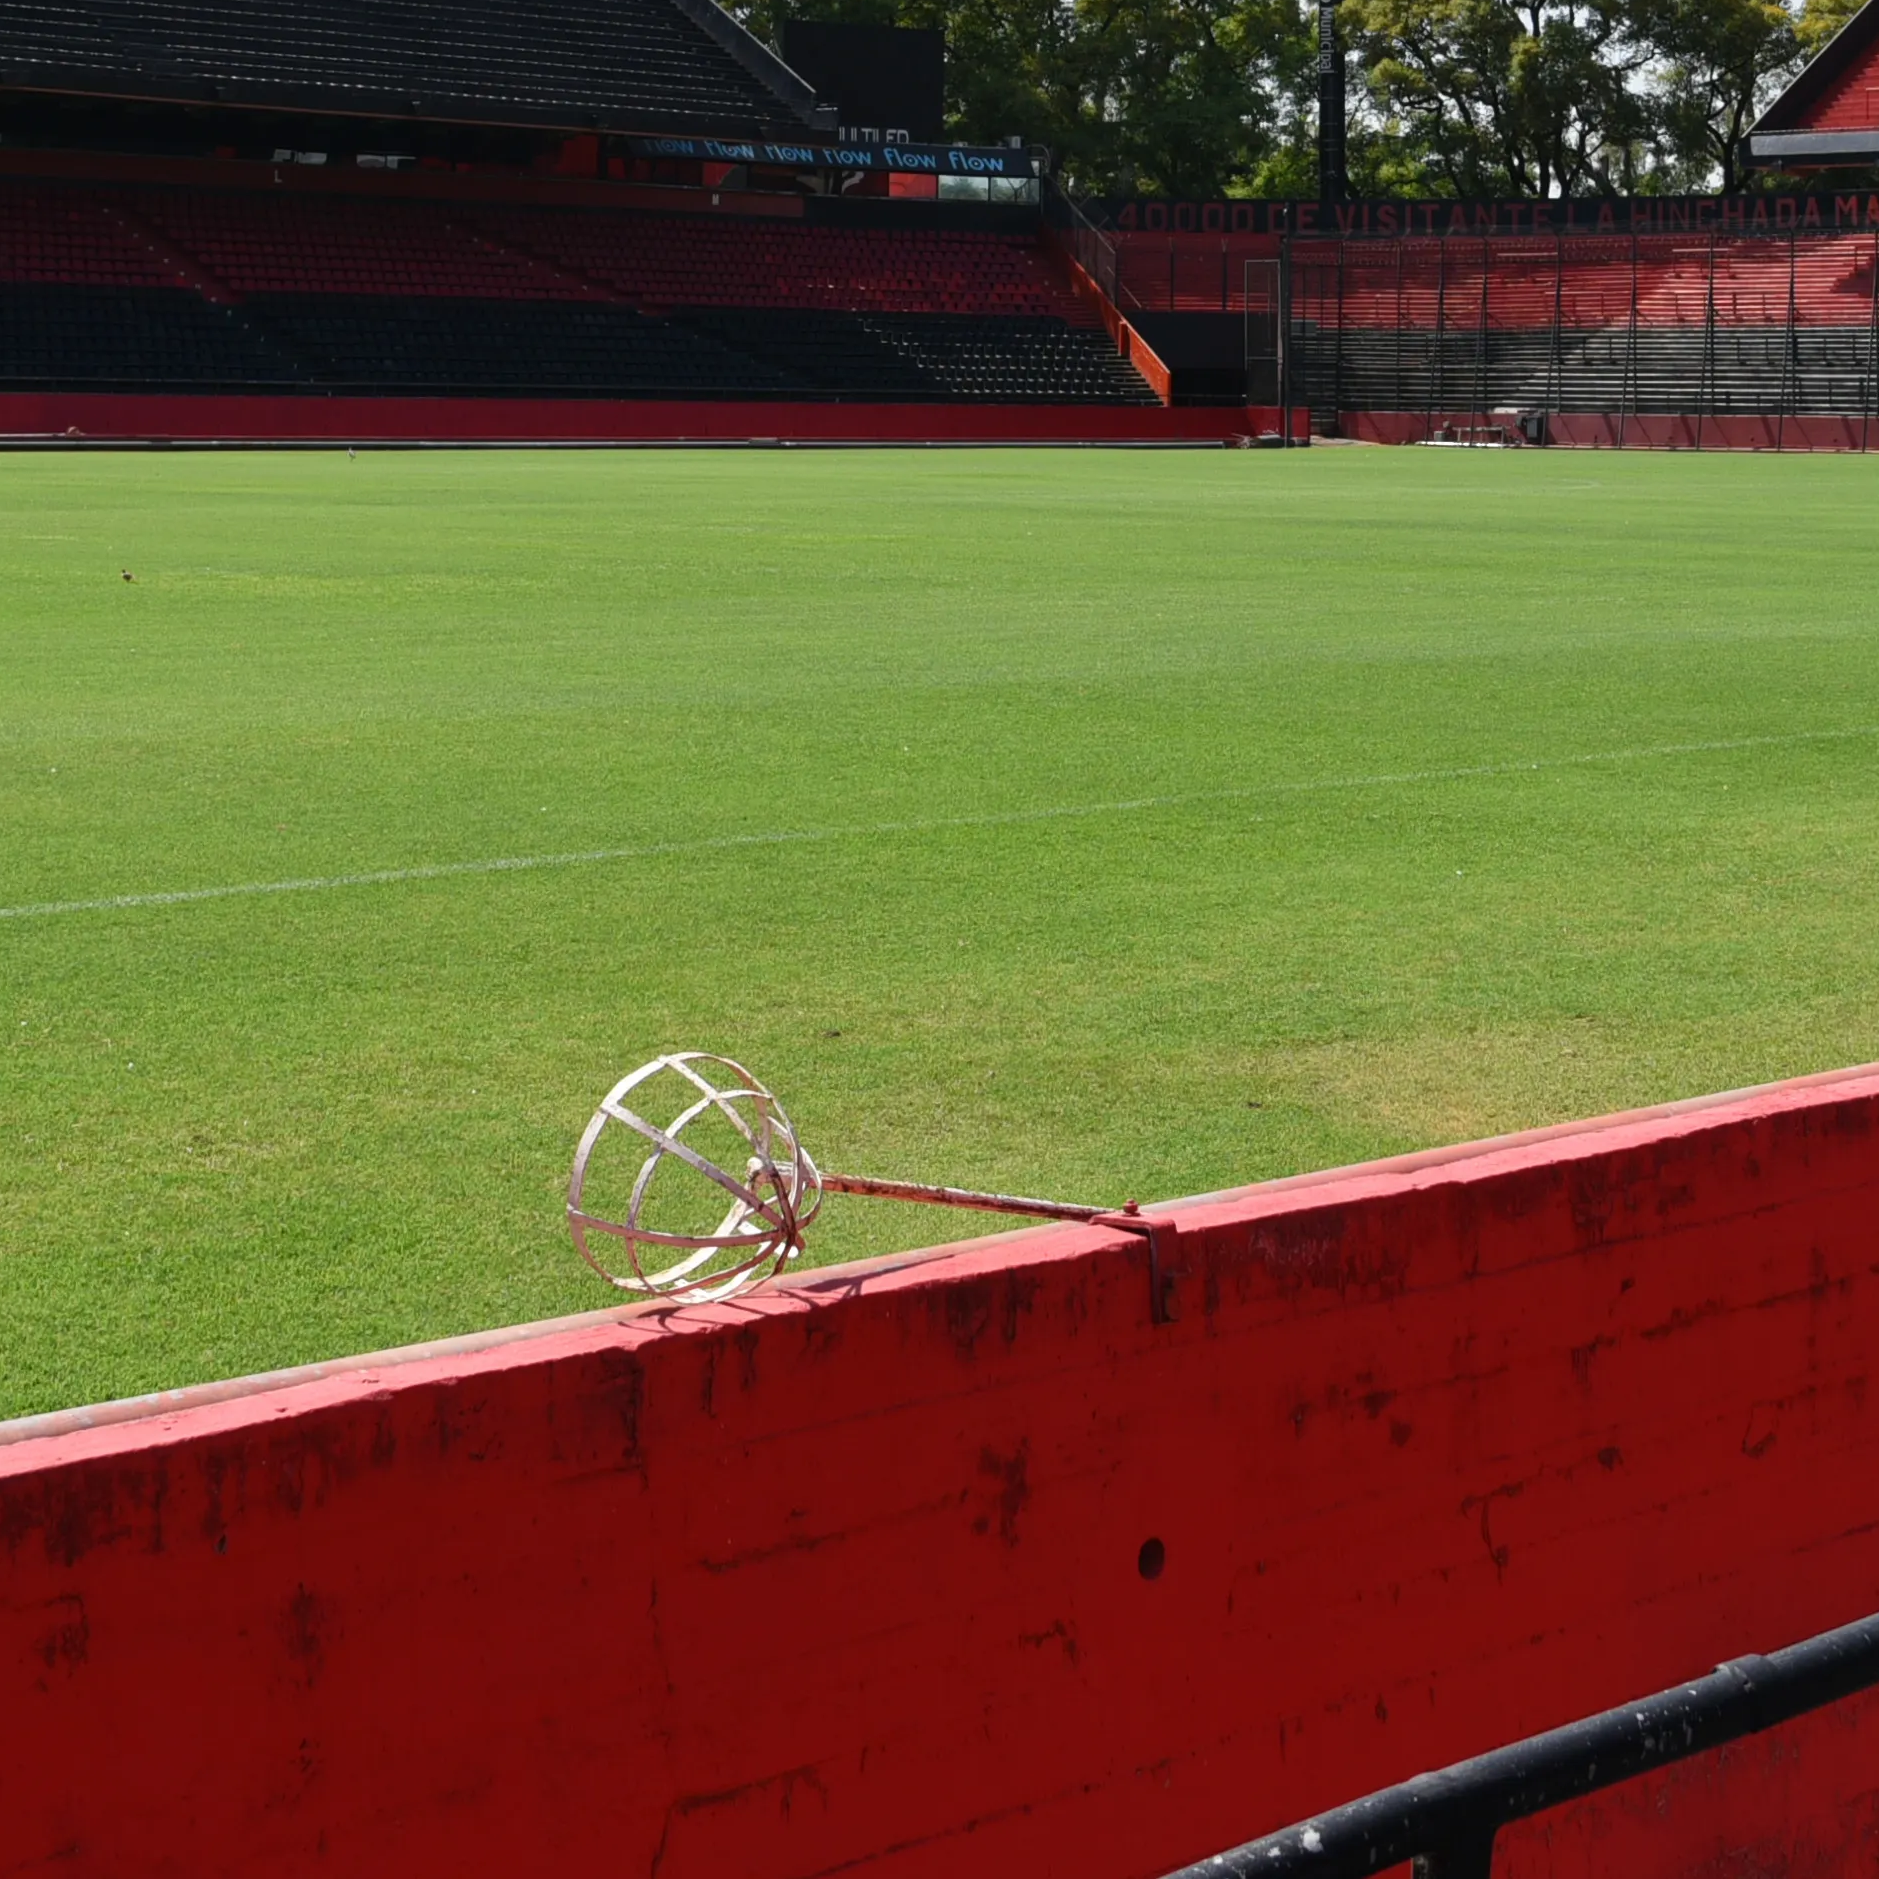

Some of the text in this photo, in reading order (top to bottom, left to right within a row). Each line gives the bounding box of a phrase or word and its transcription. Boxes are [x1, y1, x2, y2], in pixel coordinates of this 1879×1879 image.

[883, 147, 937, 169] flow
[948, 151, 1004, 173] flow
[1334, 201, 1551, 233] VISITANTE
[1567, 202, 1615, 233] LA
[1630, 197, 1822, 232] HINCHADA
